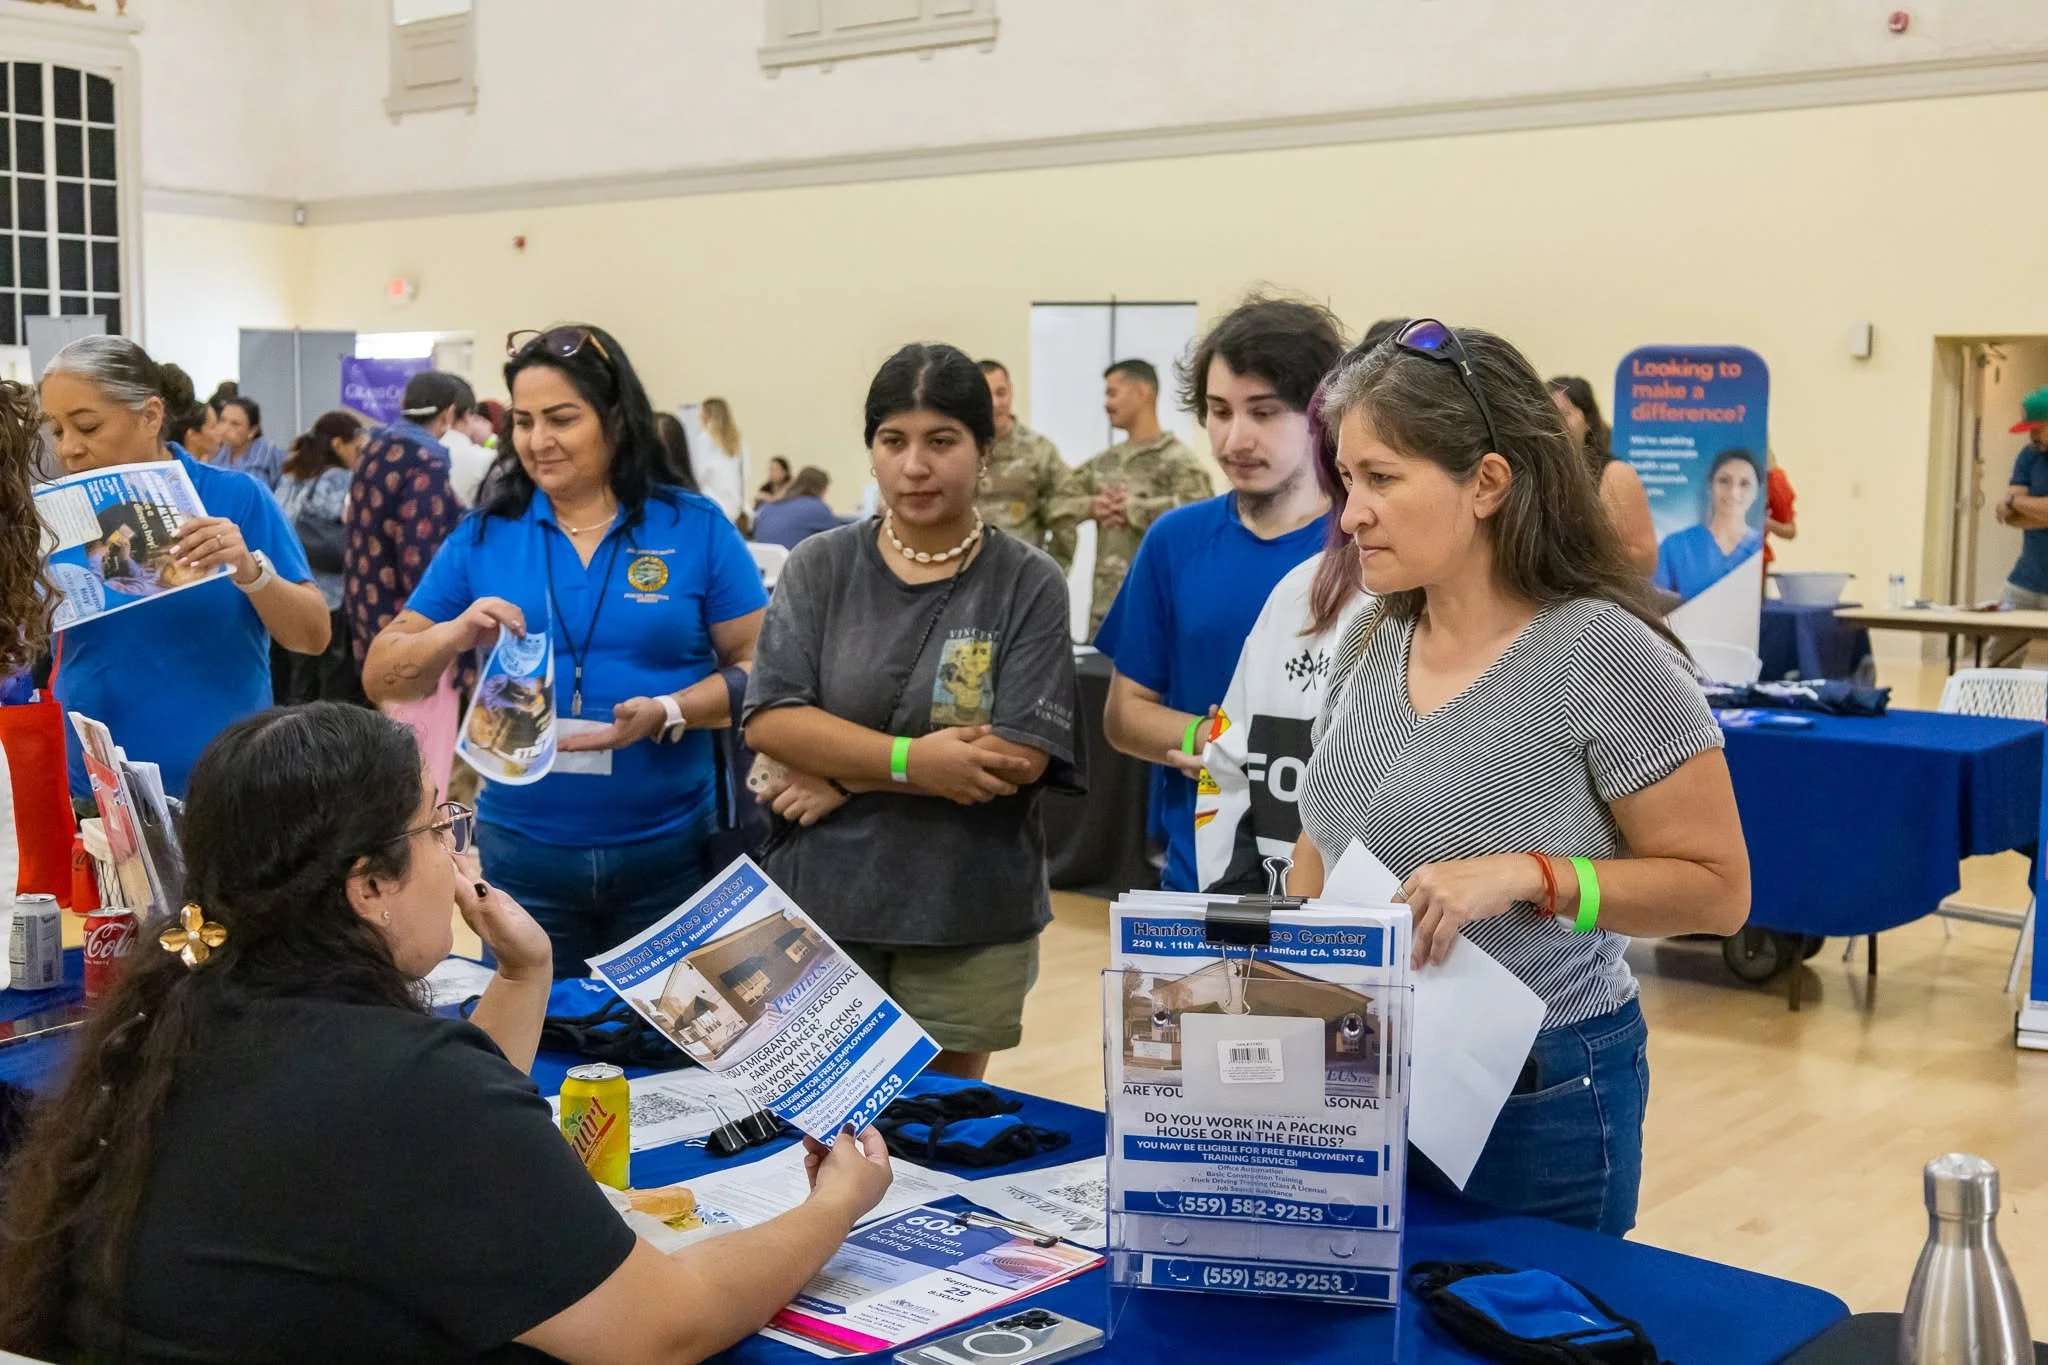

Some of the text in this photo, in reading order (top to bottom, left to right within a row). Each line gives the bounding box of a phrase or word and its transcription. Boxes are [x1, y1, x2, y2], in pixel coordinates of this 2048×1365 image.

[1632, 358, 1743, 381] Looking to
[1632, 380, 1704, 400] make a
[1632, 400, 1746, 423] difference?
[144, 529, 159, 550] hoy!
[606, 875, 745, 976] Hanford Service Center
[635, 962, 651, 977] 11th
[650, 955, 668, 969] AVE.
[666, 946, 682, 958] Ste.
[681, 941, 688, 949] A
[689, 916, 719, 942] Hanford
[717, 907, 733, 918] CA,
[731, 885, 755, 907] 93230
[1132, 939, 1152, 948] 220
[1155, 941, 1167, 949] N.
[1170, 942, 1194, 950] 11th
[1310, 949, 1329, 958] CA,
[1333, 949, 1367, 958] 93230
[1299, 930, 1366, 945] Center
[773, 963, 828, 1015] PROTEUS
[740, 1066, 750, 1074] A
[747, 1030, 792, 1069] MIGRANT
[791, 1016, 809, 1033] OR
[806, 968, 859, 1019] SEASONAL
[749, 1018, 823, 1082] FARMWORKER?
[765, 1060, 799, 1086] WORK
[796, 1048, 812, 1063] IN
[810, 1041, 821, 1053] A
[817, 998, 863, 1043] PACKING
[759, 1091, 780, 1105] OUSE
[777, 1079, 794, 1094] OR
[791, 1069, 807, 1084] IN
[804, 1051, 827, 1072] THE
[824, 1013, 863, 1052] FIELDS?
[780, 1087, 808, 1111] ELIGIBLE
[804, 1075, 821, 1091] FOR
[818, 1060, 837, 1078] FREE
[835, 1018, 880, 1061] EMPLOYMENT
[878, 1011, 886, 1019] &
[789, 1059, 852, 1114] TRAINING SERVICES!
[1122, 1085, 1150, 1096] ARE
[1325, 1097, 1380, 1110] SONAL
[1145, 1112, 1357, 1136] DO YOU WORK IN A PACKING
[1156, 1125, 1344, 1148] HOUSE OR IN THE FIELDS?
[1137, 1140, 1158, 1149] YOU
[1160, 1142, 1182, 1151] MAY
[1198, 1144, 1238, 1153] ELIGIBLE
[1240, 1146, 1260, 1154] FOR
[1262, 1147, 1285, 1156] FREE
[1287, 1150, 1355, 1162] EMPLOYMENT
[1357, 1155, 1365, 1163] &
[1202, 1153, 1298, 1167] TRAINING SERVICES!
[1217, 1164, 1284, 1175] Office Automation
[1227, 1172, 1273, 1181] Construction
[1275, 1175, 1303, 1186] Training
[1212, 1178, 1237, 1186] Driving
[1178, 1196, 1323, 1222] (559) 582-9253
[892, 1222, 962, 1248] Technician
[905, 1215, 968, 1236] 608
[866, 1232, 913, 1252] Testing
[879, 1228, 965, 1257] Certification
[943, 1277, 999, 1296] September
[1203, 1265, 1343, 1293] (559) 582-9253
[928, 1291, 965, 1304] 8:30am
[944, 1286, 972, 1297] 29
